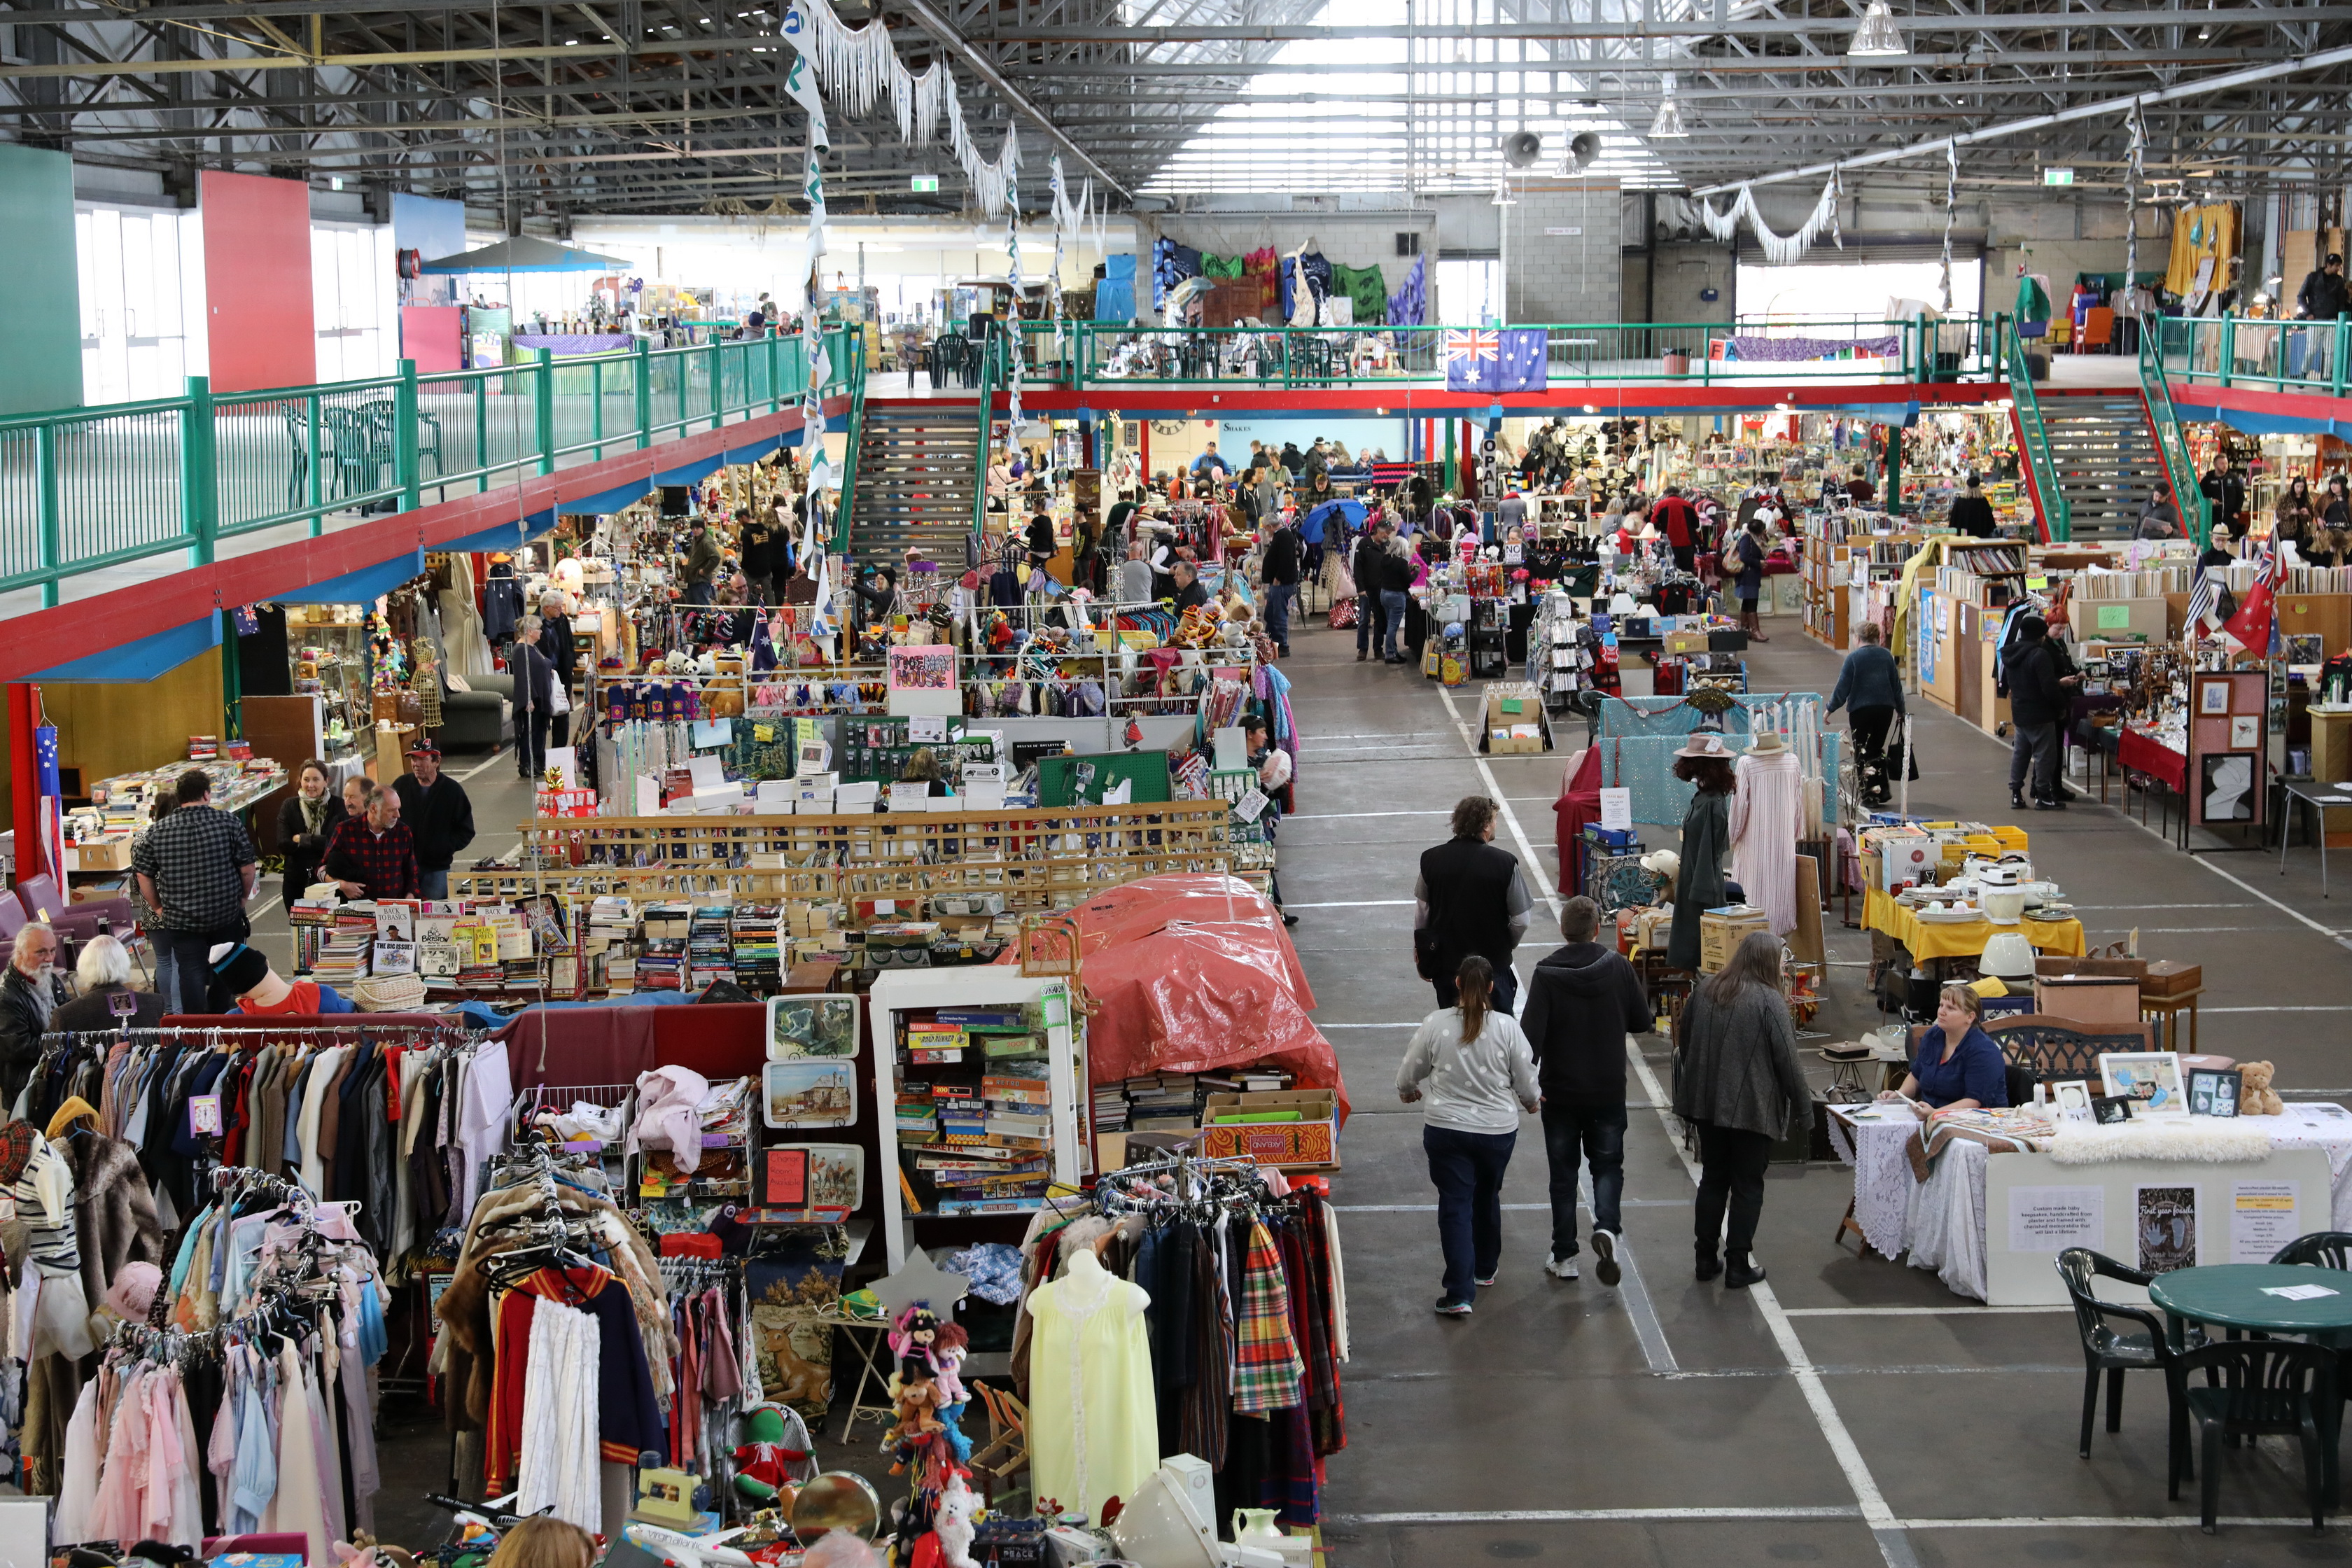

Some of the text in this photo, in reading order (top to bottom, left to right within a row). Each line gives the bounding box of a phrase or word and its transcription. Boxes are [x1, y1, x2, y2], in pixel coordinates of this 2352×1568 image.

[1484, 440, 1496, 496] OPAL
[1506, 545, 1520, 553] NO
[891, 654, 953, 671] THE HAT
[896, 670, 947, 688] HOUSE
[1613, 862, 1624, 872] PORT
[2197, 1078, 2212, 1087] Cody
[922, 1143, 964, 1153] BARETTA
[771, 1154, 801, 1166] Change
[2139, 1204, 2194, 1218] First year fossils
[455, 1500, 472, 1508] ZEALAND
[647, 1530, 703, 1550] virgin atlantic
[762, 1546, 779, 1561] Virgin
